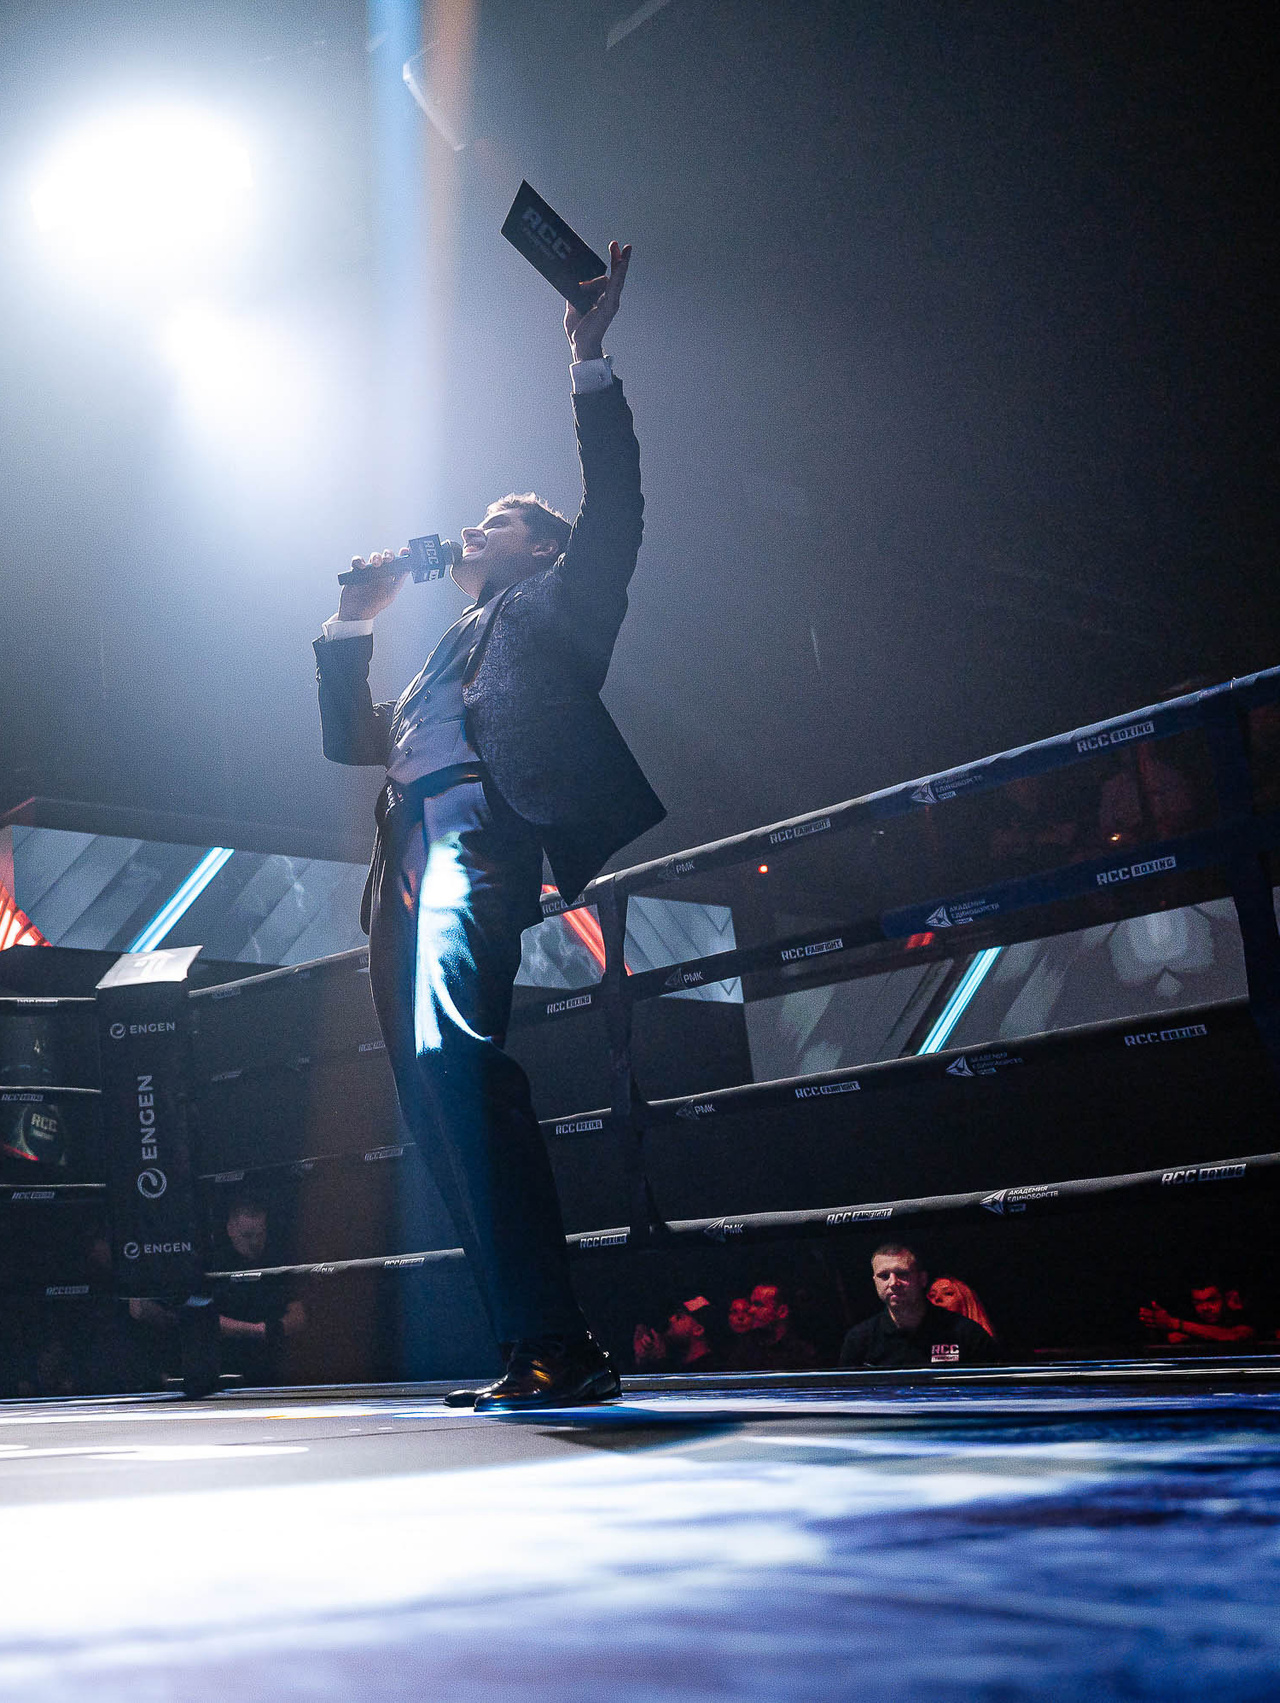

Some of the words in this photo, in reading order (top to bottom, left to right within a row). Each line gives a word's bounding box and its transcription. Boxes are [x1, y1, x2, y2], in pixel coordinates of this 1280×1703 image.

[1077, 734, 1110, 753] RCC
[1111, 721, 1154, 743] BOXING
[770, 828, 794, 844] RCC
[794, 818, 830, 837] FAIRFIGHT
[1096, 867, 1130, 886] RCC
[1131, 857, 1176, 877] BOXING
[781, 947, 805, 961] RCC
[806, 939, 842, 956] FAIRFIGHT
[546, 1001, 565, 1015] RCC
[128, 1022, 175, 1035] ENGEN
[1124, 1032, 1159, 1046] RCC
[1160, 1024, 1207, 1041] BOXING
[795, 1087, 820, 1098] RCC
[136, 1074, 157, 1161] ENGEN
[555, 1123, 575, 1136] RCC
[1161, 1170, 1197, 1186] RCC
[1199, 1164, 1245, 1181] BOXING
[826, 1212, 851, 1226] RCC
[852, 1209, 893, 1222] FAIRFIGHT
[143, 1242, 190, 1255] ENGEN
[931, 1344, 959, 1355] RCC
